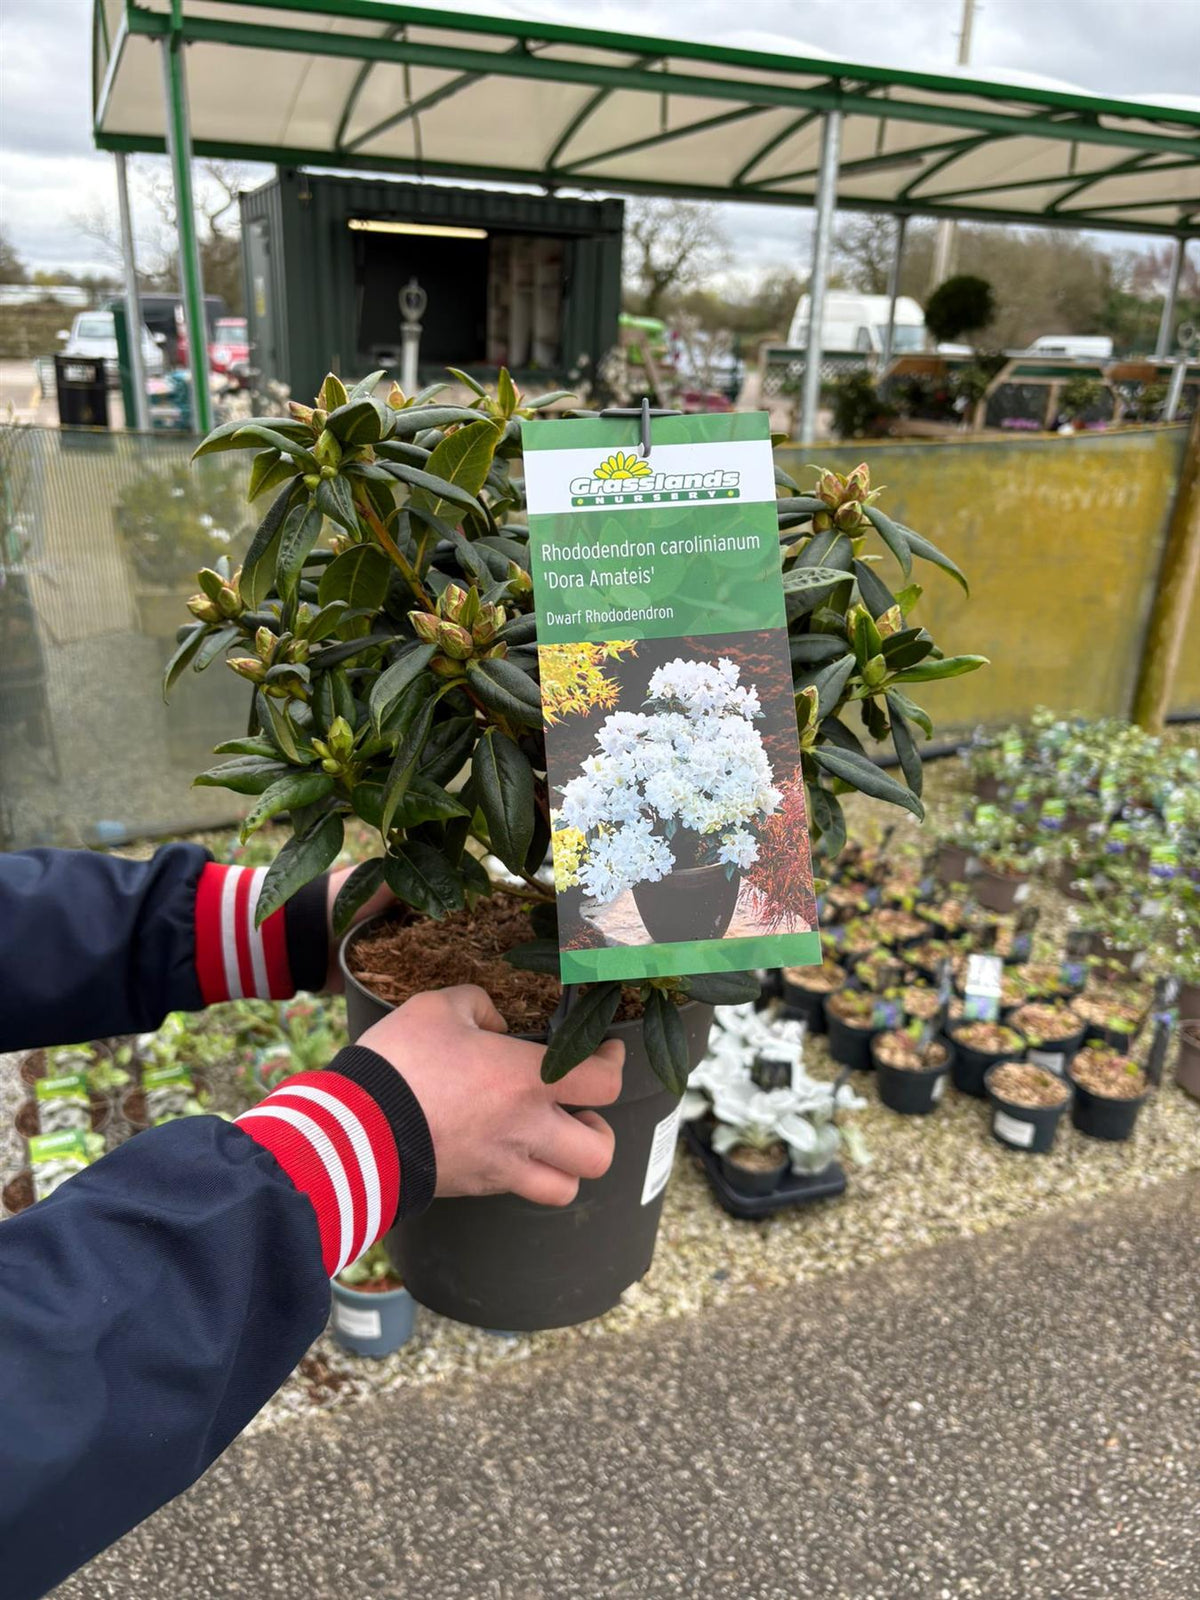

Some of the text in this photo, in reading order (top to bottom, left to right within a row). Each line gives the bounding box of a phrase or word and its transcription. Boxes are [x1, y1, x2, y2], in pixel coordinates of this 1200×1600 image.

[570, 470, 739, 494] Grasslands
[595, 490, 716, 504] NURSERY
[541, 534, 760, 562] Rhododendron carolinianum
[544, 567, 655, 589] 'Dora Amateis'
[546, 605, 674, 625] Dwarf Rhododendron
